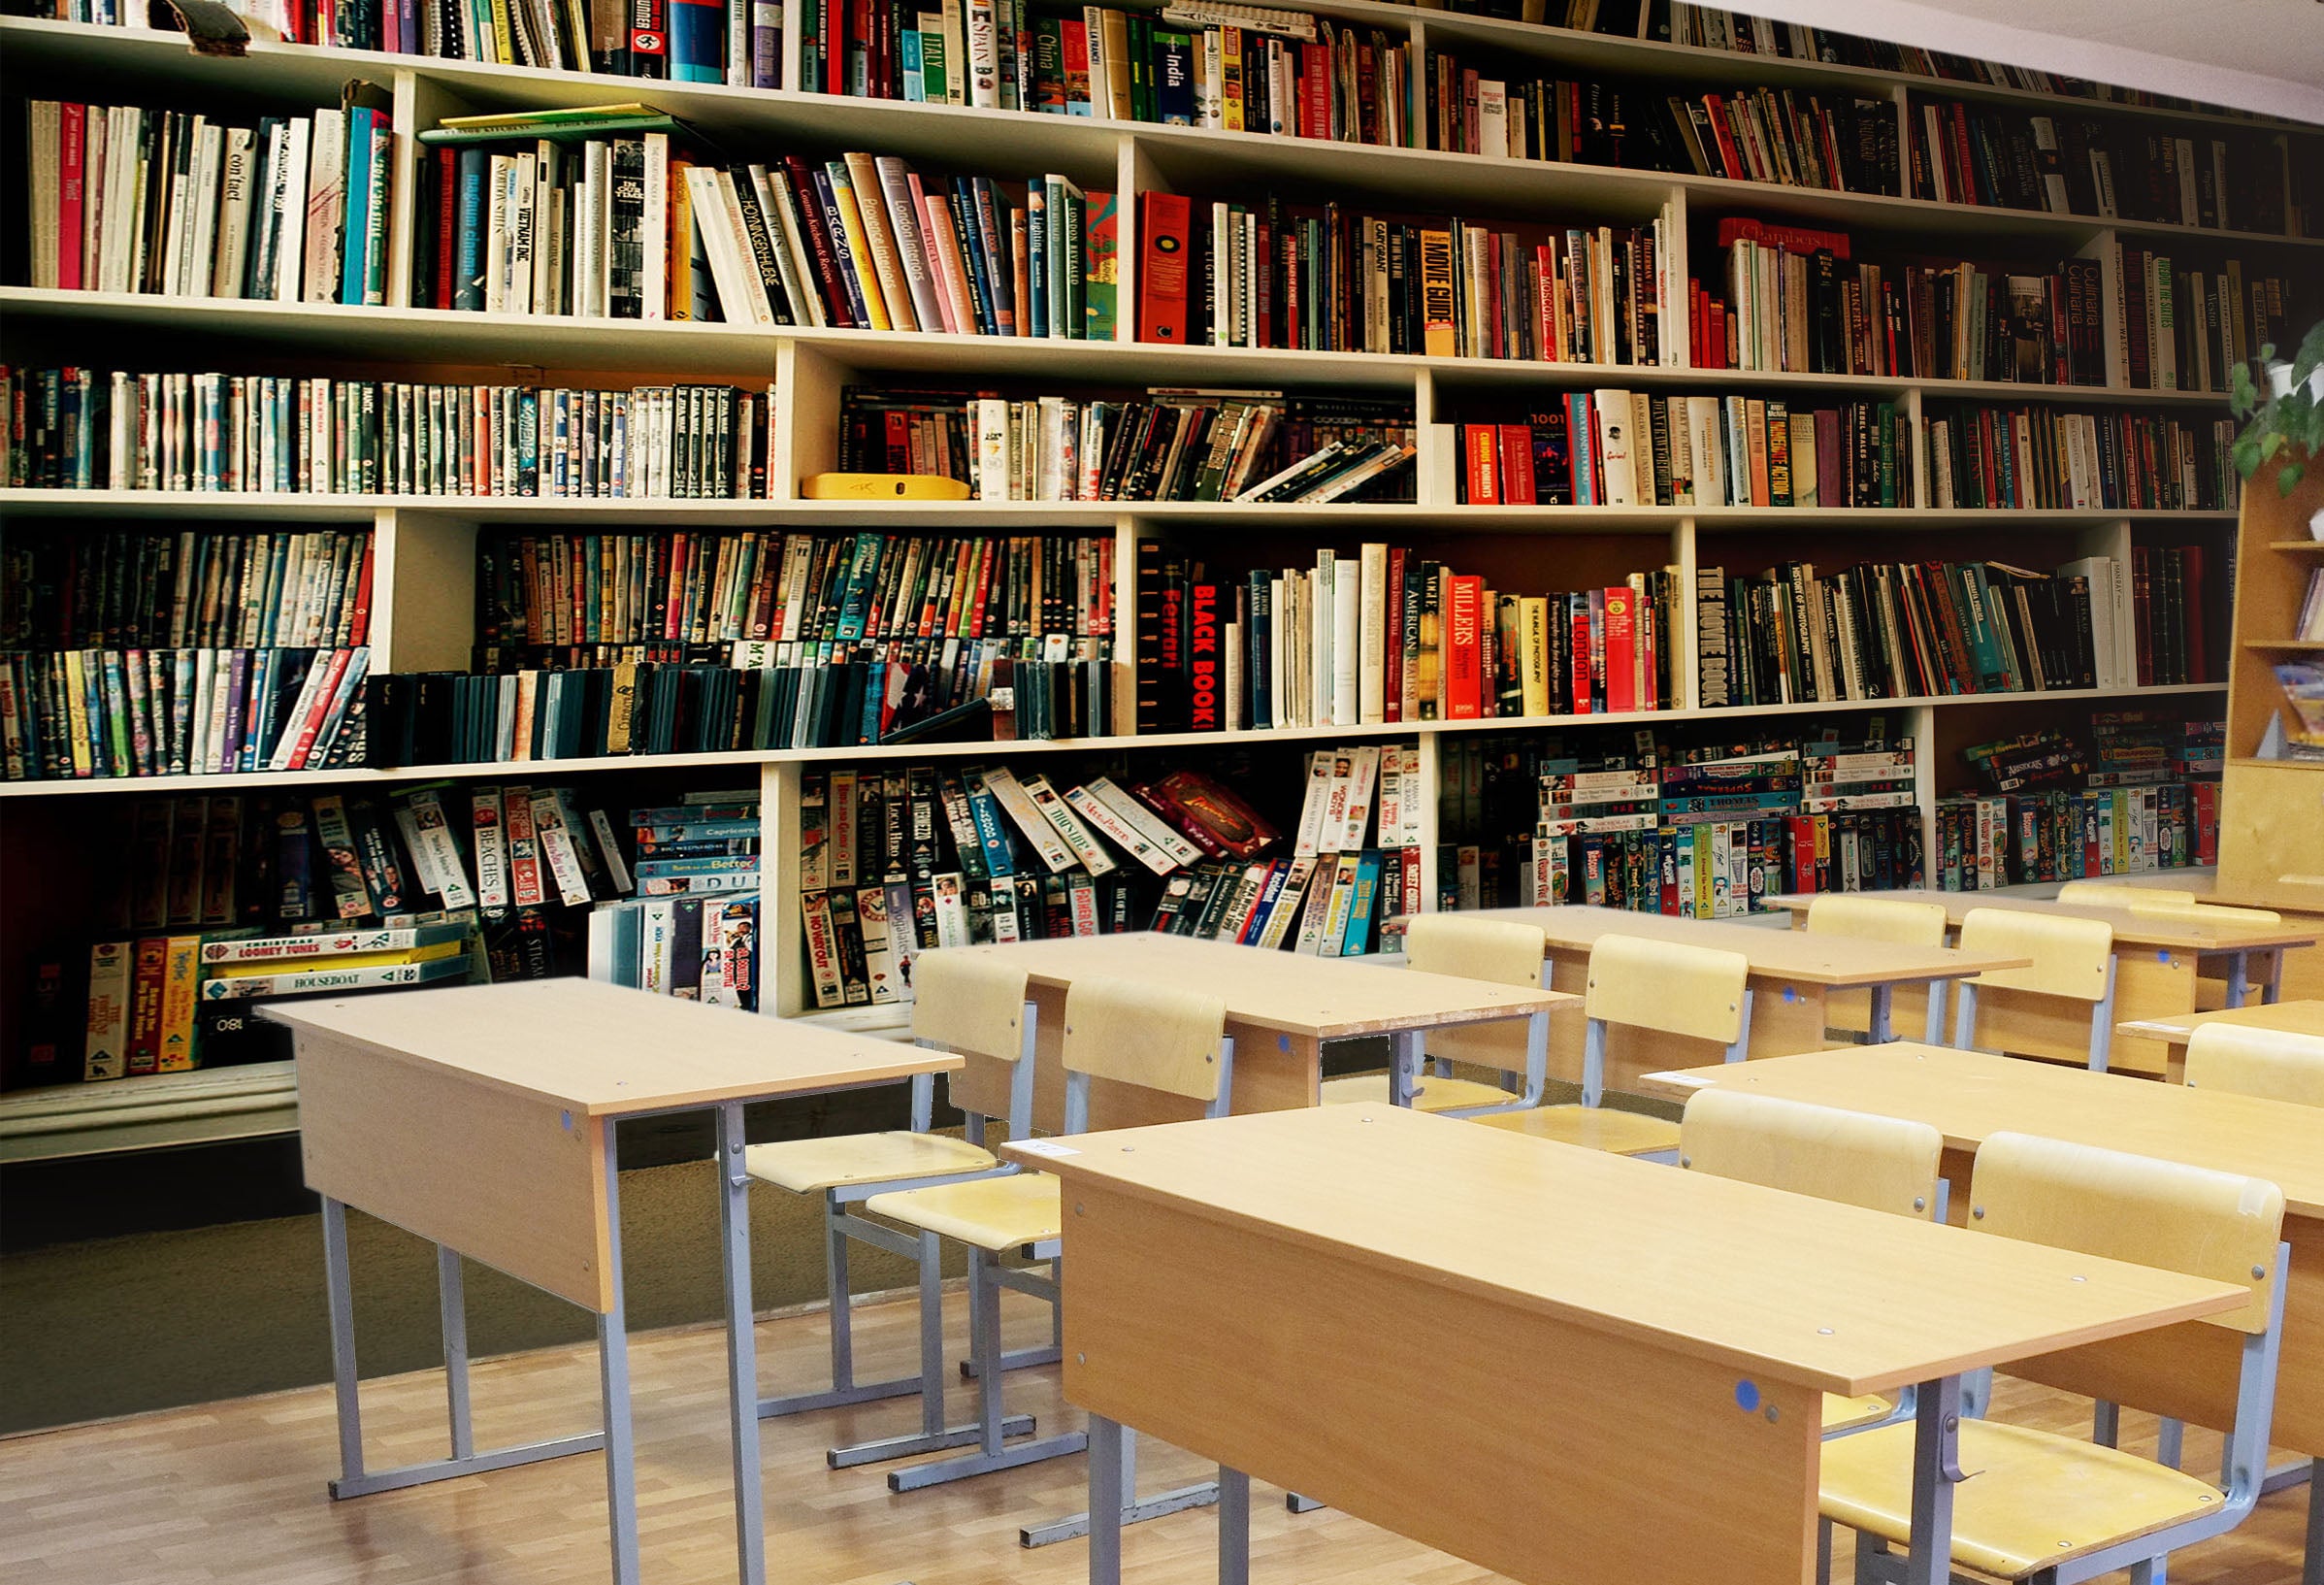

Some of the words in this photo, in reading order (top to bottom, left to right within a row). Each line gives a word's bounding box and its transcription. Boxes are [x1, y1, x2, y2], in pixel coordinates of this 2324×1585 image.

[604, 36, 614, 65] Birdsong
[924, 38, 942, 68] ITALY
[973, 24, 992, 62] SPAIN
[1037, 34, 1057, 69] China
[1017, 51, 1028, 92] Mallorca
[1165, 54, 1184, 86] India
[1590, 83, 1601, 116] Olivier
[1856, 117, 1876, 161] STALINGRAD
[495, 163, 507, 201] SNOWDON
[464, 173, 481, 227] magnum
[800, 189, 815, 217] Country
[980, 191, 990, 203] the
[372, 212, 381, 237] STYLE
[495, 206, 506, 235] STILLS
[518, 208, 531, 245] VIETNAM
[806, 219, 823, 248] Kitchens
[828, 206, 849, 260] BARNS
[981, 205, 996, 234] flooring
[1069, 207, 1079, 241] LONDON
[1376, 223, 1385, 243] CARY
[551, 231, 560, 266] ALCATRAZ
[741, 200, 779, 285] HOYNINGEN-HUENE
[863, 198, 885, 244] Provence
[876, 246, 898, 289] Interiors
[895, 200, 914, 238] London
[906, 240, 925, 281] Interiors
[989, 235, 999, 252] book
[1031, 217, 1043, 253] Lighting
[1102, 234, 1112, 253] ANDY
[1741, 224, 1822, 247] Chambers
[464, 230, 479, 276] cinema
[1070, 246, 1079, 285] REVEALED
[1376, 245, 1386, 273] GRANT
[1424, 243, 1450, 283] MOVIE
[1572, 239, 1585, 277] SKELETON
[1643, 238, 1653, 280] HILLERMAN
[819, 258, 834, 283] Recipes
[1102, 255, 1113, 284] WARHOL
[1205, 251, 1214, 311] LIGHTING
[2158, 259, 2171, 285] AVEDON
[1426, 287, 1451, 322] GUIDE
[1542, 276, 1553, 322] MOSCOW
[1575, 280, 1585, 304] COAST
[1850, 282, 1861, 331] BAKERY
[2068, 264, 2085, 325] Culinaria
[2084, 266, 2099, 326] Culinaria
[2160, 288, 2172, 300] THE
[2255, 290, 2265, 320] GILBERT
[2160, 302, 2174, 328] SIXTIES
[2208, 293, 2217, 327] Weston
[2233, 294, 2242, 325] Sander
[363, 387, 374, 414] FRANTIC
[1679, 402, 1688, 426] TERRY
[493, 410, 503, 450] ENTRAPMENT
[1530, 413, 1564, 424] 1001
[1638, 412, 1647, 439] McEWAN
[1480, 432, 1490, 462] CURIOUS
[1517, 441, 1525, 450] The
[1771, 420, 1786, 464] IMMEDIATE
[1967, 423, 1980, 480] GREENS
[1482, 464, 1492, 498] MOMENTS
[1773, 466, 1788, 495] ACTION
[2004, 469, 2013, 489] YOGA
[864, 543, 878, 574] MONTY
[1391, 559, 1399, 592] VICTORIAN
[1697, 567, 1724, 599] THE
[1792, 567, 1804, 595] HISTORY
[1425, 576, 1438, 607] VOGUE
[1751, 590, 1760, 613] English
[1795, 597, 1805, 606] OF
[1822, 586, 1833, 613] SMALLER
[1194, 585, 1216, 652] BLACK
[1406, 589, 1419, 650] AMERICAN
[1454, 582, 1474, 645] MILLER'S
[1826, 614, 1836, 641] GARDEN
[1162, 589, 1182, 668] Ferrari
[1699, 602, 1726, 655] MOVIE
[1796, 607, 1810, 656] PHOTOGRAPHY
[1551, 649, 1559, 661] first
[1574, 621, 1588, 681] London
[1405, 656, 1418, 701] REALISM
[1551, 662, 1559, 677] eighty
[1701, 657, 1728, 707] BOOK
[1193, 661, 1215, 729] BOOK!
[945, 801, 961, 822] WAR
[956, 798, 969, 816] WAS
[1329, 791, 1338, 815] BOYS
[1334, 785, 1347, 822] WONDER
[1709, 796, 1759, 805] THOMAS
[889, 802, 902, 830] LOCAL
[912, 801, 932, 841] INTERMEZZO
[1381, 809, 1391, 830] Heart
[706, 828, 756, 837] Capricorn
[889, 832, 902, 857] HERO
[480, 829, 498, 888] BEACHES
[711, 859, 748, 870] Better
[1218, 879, 1230, 899] TANGO
[1262, 872, 1284, 903] Accident
[1406, 864, 1418, 886] SWEET
[1076, 889, 1092, 919] FATHER
[1115, 887, 1127, 899] DAY
[1230, 879, 1249, 912] Highlights
[1238, 898, 1254, 916] World
[811, 915, 822, 931] NO
[1115, 909, 1126, 923] THE
[1207, 908, 1219, 923] CASH
[1223, 914, 1236, 931] 1999
[1231, 917, 1246, 935] Tour
[813, 932, 825, 950] WAY
[890, 908, 909, 954] yogalates
[238, 945, 282, 958] LOONEY
[286, 943, 320, 955] TUNES
[816, 951, 828, 968] OUT
[294, 974, 360, 989] HOUSEBOAT
[724, 962, 735, 987] DOLITTLE
[736, 959, 749, 983] DOLITTLE
[149, 987, 159, 1006] Bear
[135, 1015, 146, 1040] House
[147, 1018, 157, 1031] the
